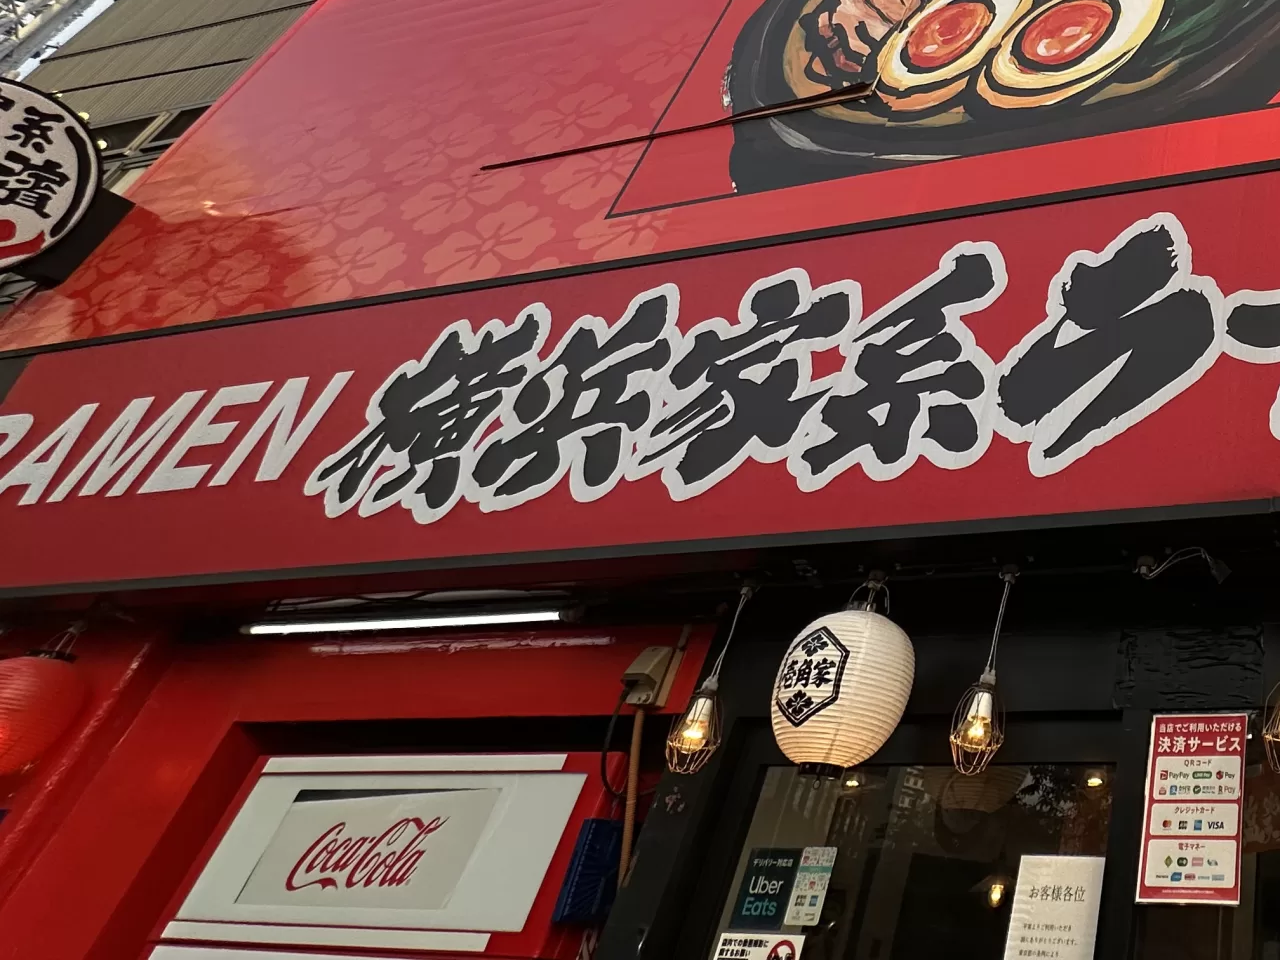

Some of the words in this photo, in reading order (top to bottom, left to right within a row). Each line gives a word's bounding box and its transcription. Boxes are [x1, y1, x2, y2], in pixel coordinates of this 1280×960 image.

[783, 657, 836, 689] 壱角家
[1159, 722, 1242, 733] 当店でご利用いただける
[1158, 735, 1241, 753] 決済サービス
[1169, 772, 1190, 780] PayPay
[1174, 806, 1215, 814] クレジットカード
[1208, 821, 1224, 829] VISA
[1178, 842, 1206, 851] 電子マネー
[748, 876, 784, 895] Uber
[1028, 885, 1086, 902] お客様各位
[741, 896, 777, 916] Eats
